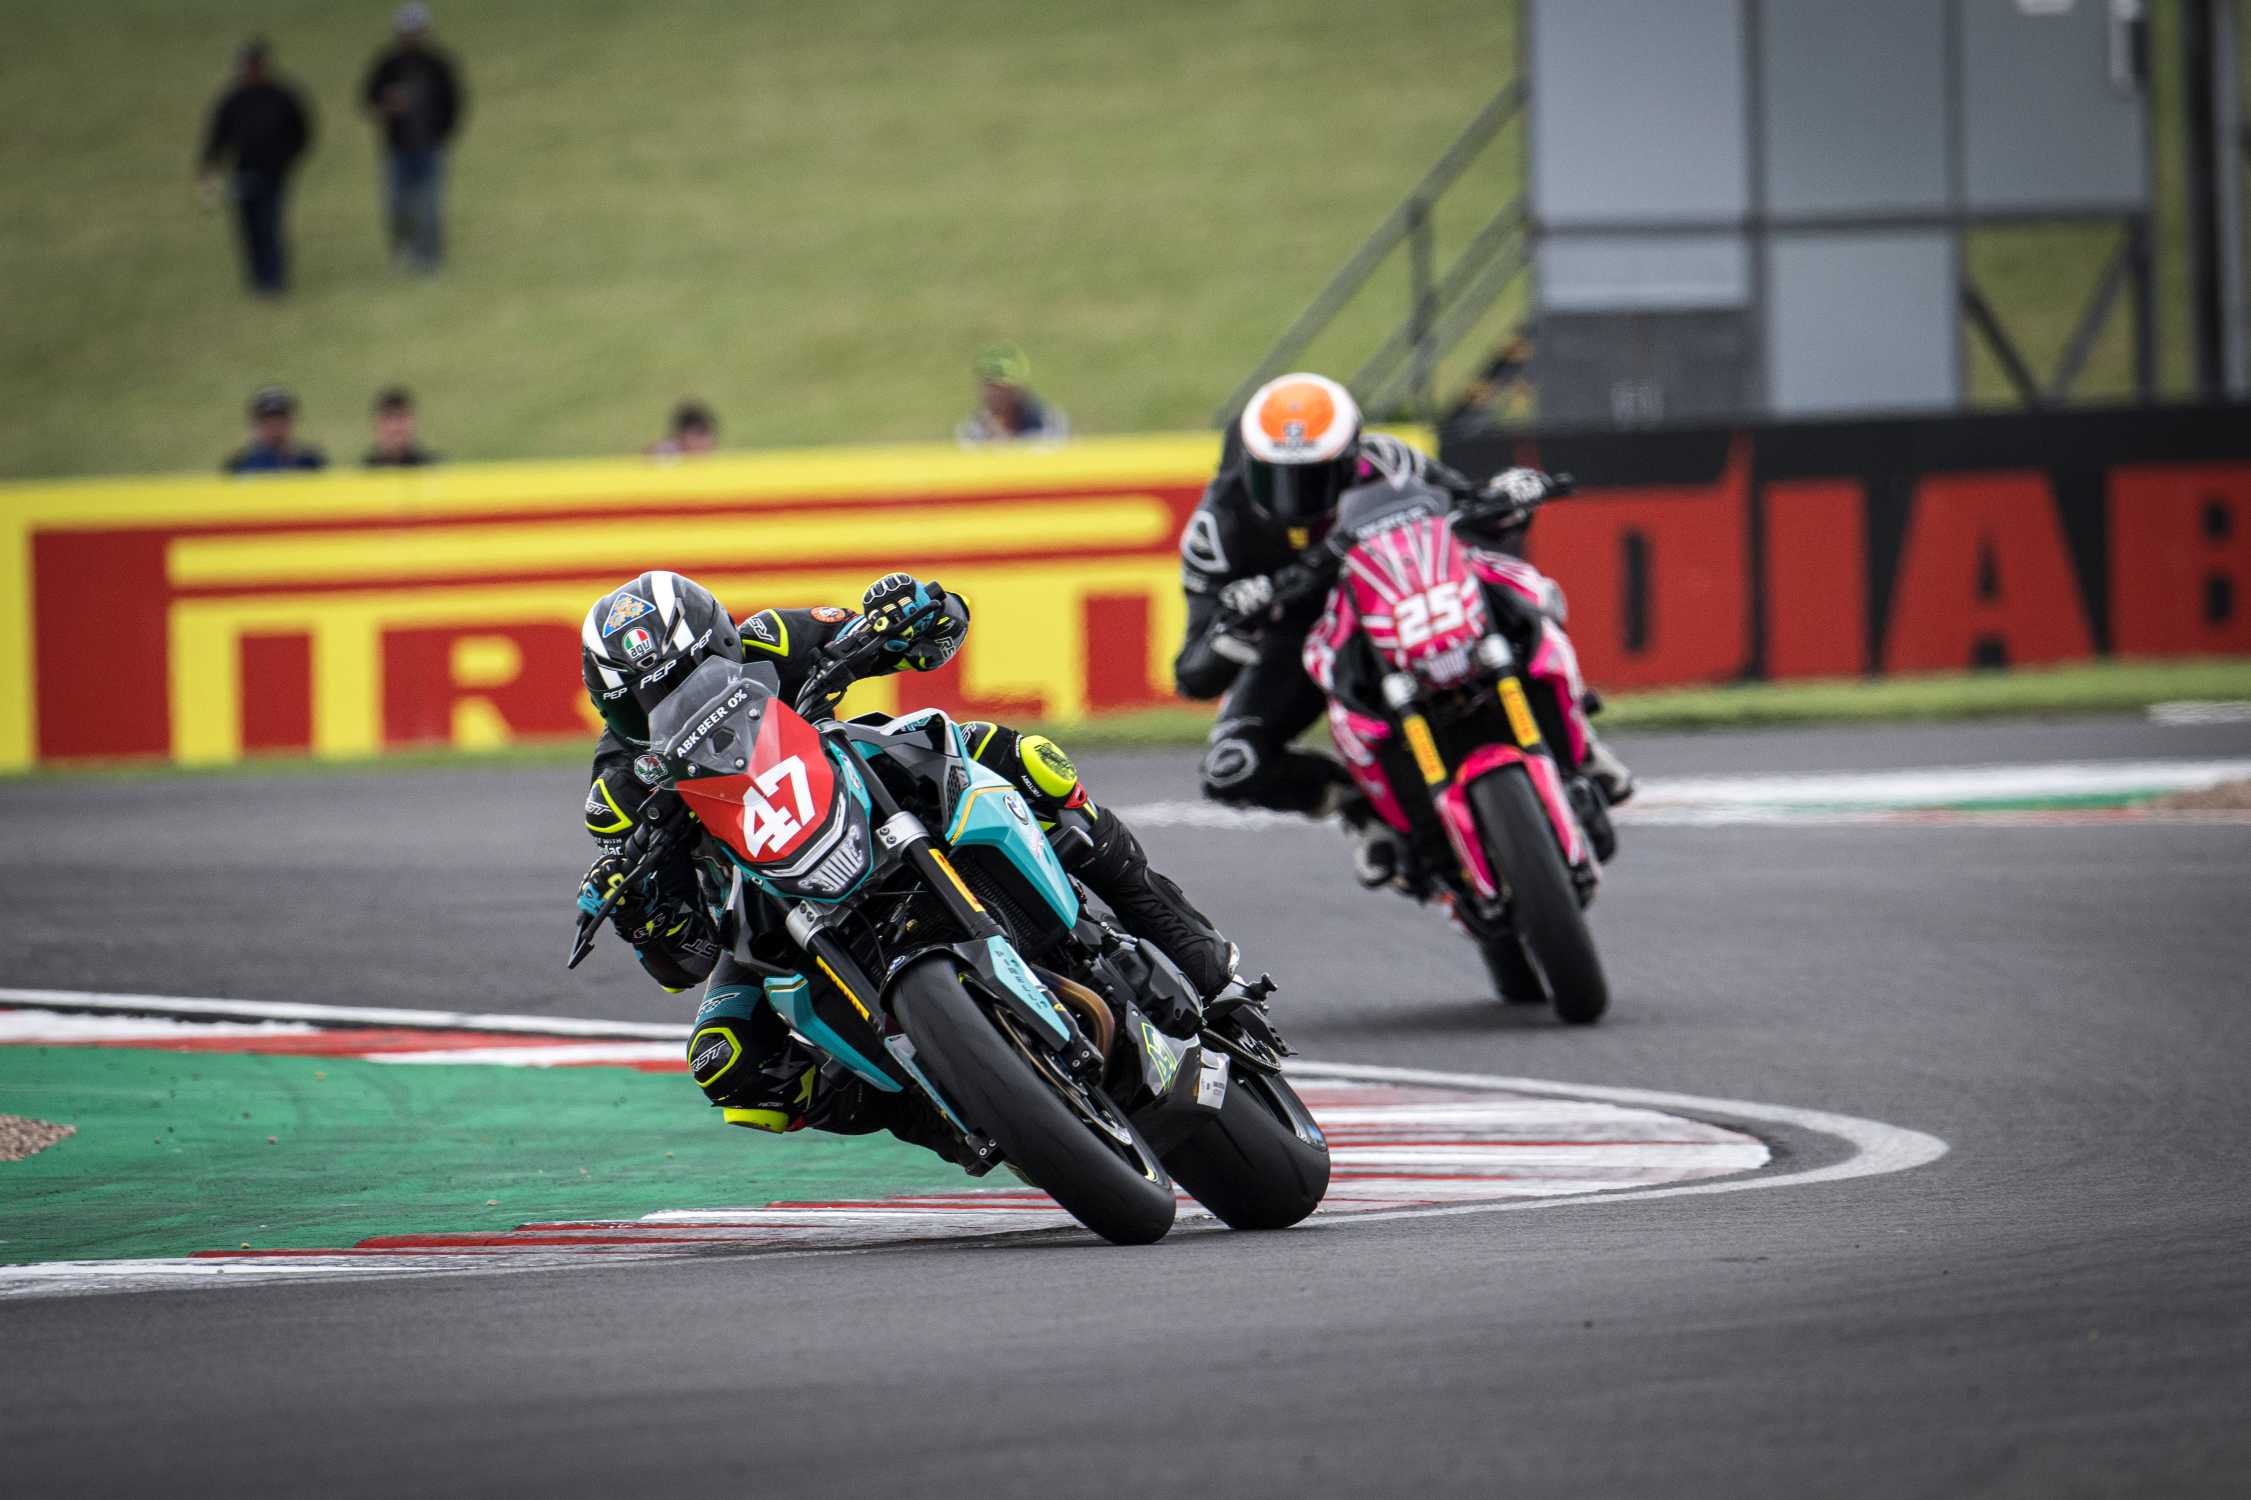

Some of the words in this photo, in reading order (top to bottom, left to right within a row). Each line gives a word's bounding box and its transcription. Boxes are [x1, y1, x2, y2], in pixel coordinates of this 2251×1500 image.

[30, 482, 1212, 768] PIRLL
[1398, 581, 1465, 648] 25
[691, 628, 713, 656] PEP
[603, 687, 628, 700] PEP
[640, 659, 677, 690] PEP
[676, 732, 700, 758] ABK
[696, 706, 728, 736] BEER
[727, 688, 748, 708] 0%
[742, 755, 816, 858] 47
[690, 1039, 728, 1072] RST
